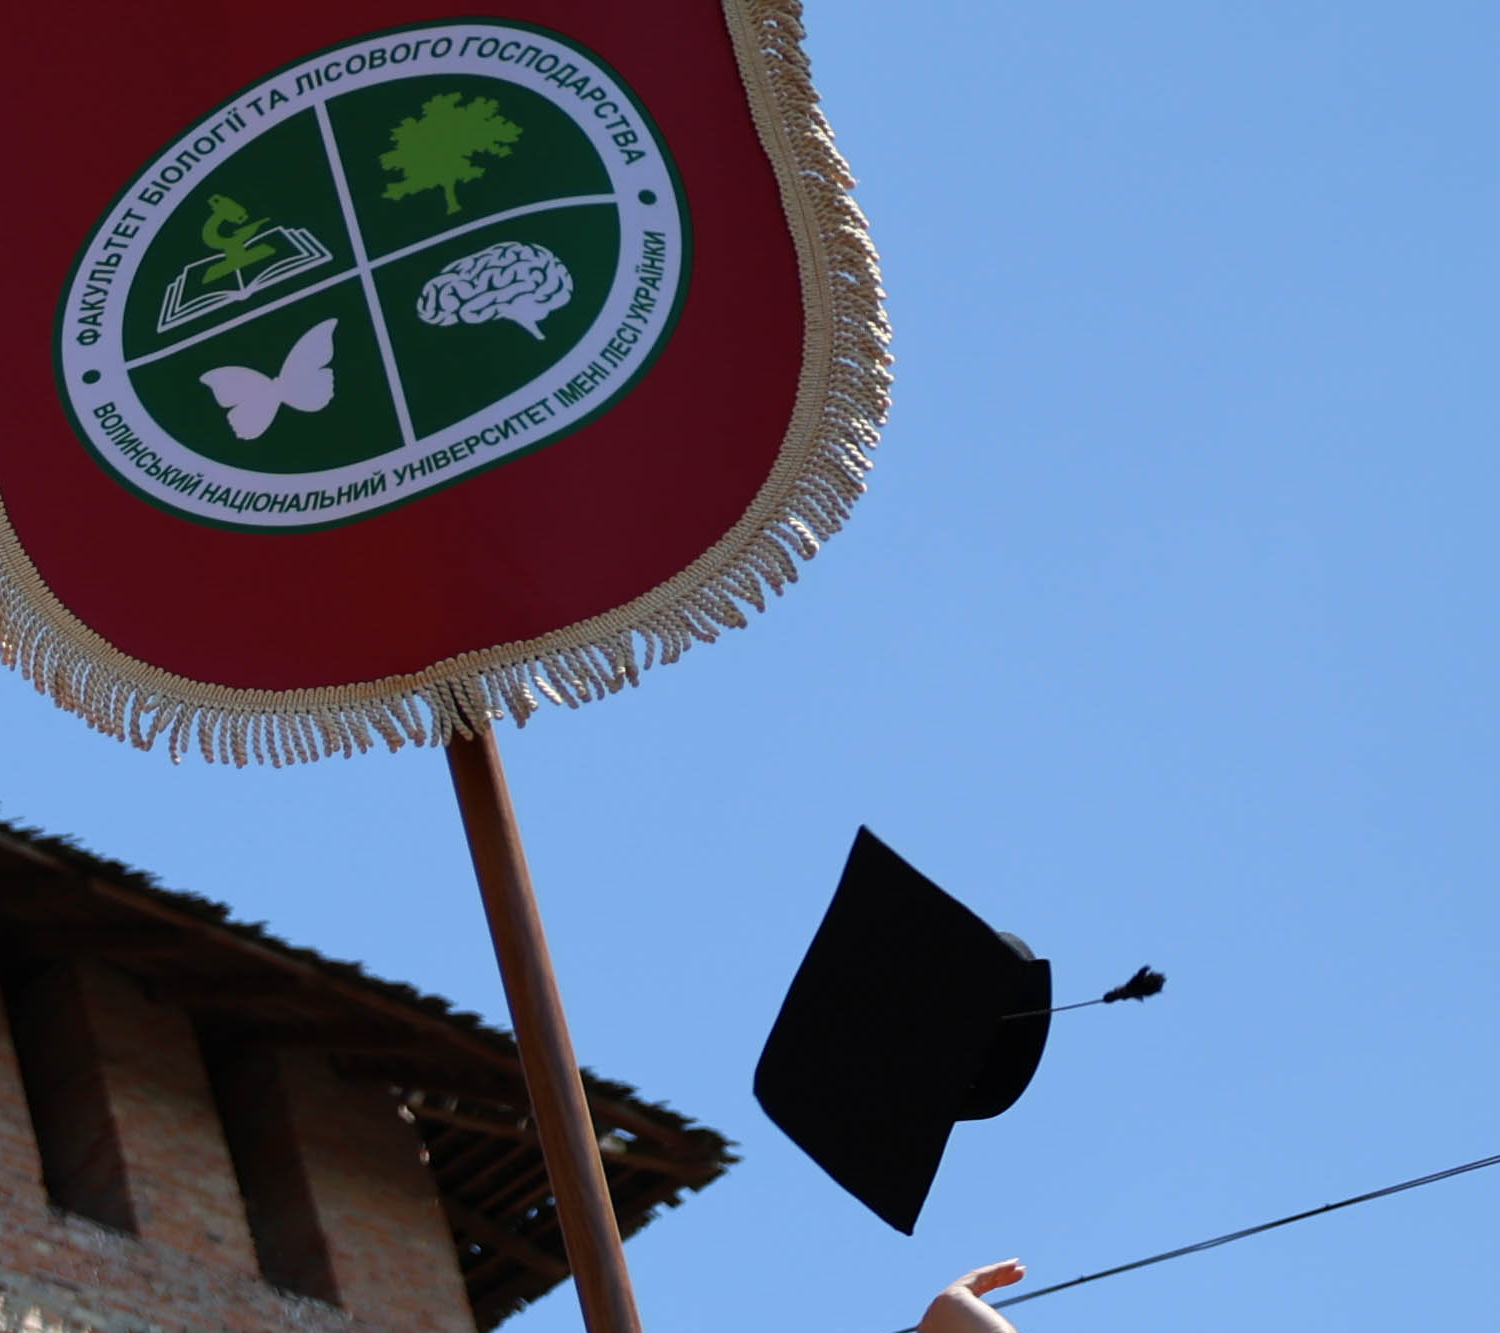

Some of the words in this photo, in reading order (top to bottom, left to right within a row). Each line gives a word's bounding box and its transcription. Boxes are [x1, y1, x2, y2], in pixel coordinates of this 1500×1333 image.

[76, 207, 148, 346] ФАКУЛЬТЕТ
[138, 107, 247, 206] БІОЛОГІЇ
[247, 88, 289, 117] ТА
[295, 37, 453, 96] ЛІСОВОГО
[459, 36, 646, 165] ГОСПОДАРСТВА
[92, 401, 204, 497] ВОЛИНСЬКИЙ
[198, 470, 387, 513] НАЦІОНАЛЬНИЙ
[393, 398, 557, 486] УНІВЕРСИТЕТ
[553, 361, 611, 408] ІМЕНІ
[599, 322, 643, 369] ЛЕСІ
[626, 230, 667, 324] УКРАЇНКИ
